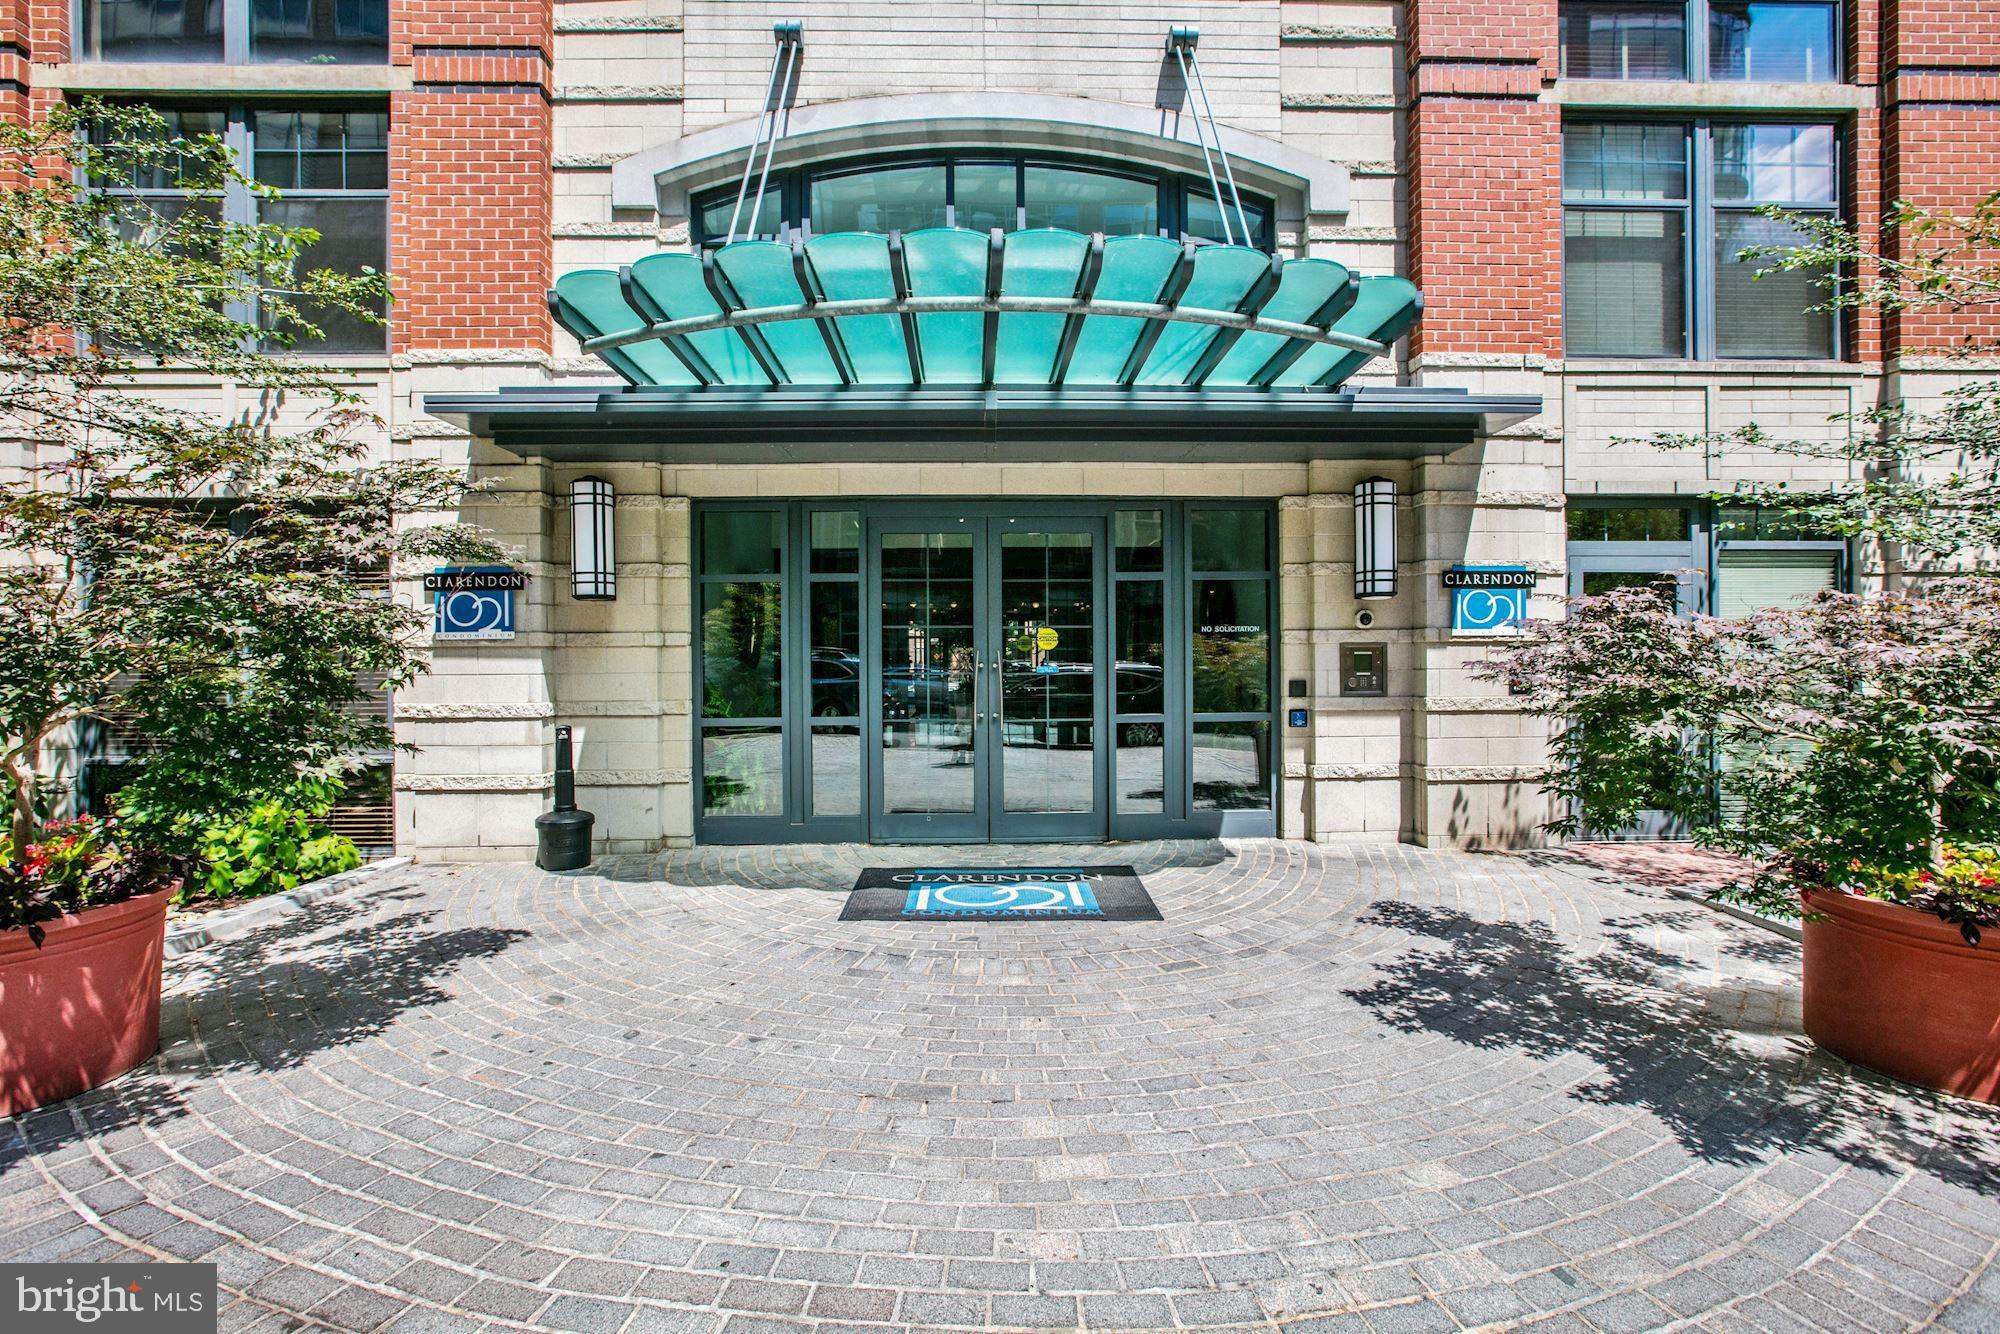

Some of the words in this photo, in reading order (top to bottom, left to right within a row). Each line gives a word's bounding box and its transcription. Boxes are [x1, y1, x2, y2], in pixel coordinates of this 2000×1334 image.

[425, 575, 521, 588] CLARENDON
[1444, 573, 1535, 585] CLARENDON
[1201, 625, 1212, 633] NO
[1214, 625, 1260, 633] SOLICITATION
[891, 873, 1104, 883] CLARENDON
[901, 908, 1105, 917] CONDOMINIUM
